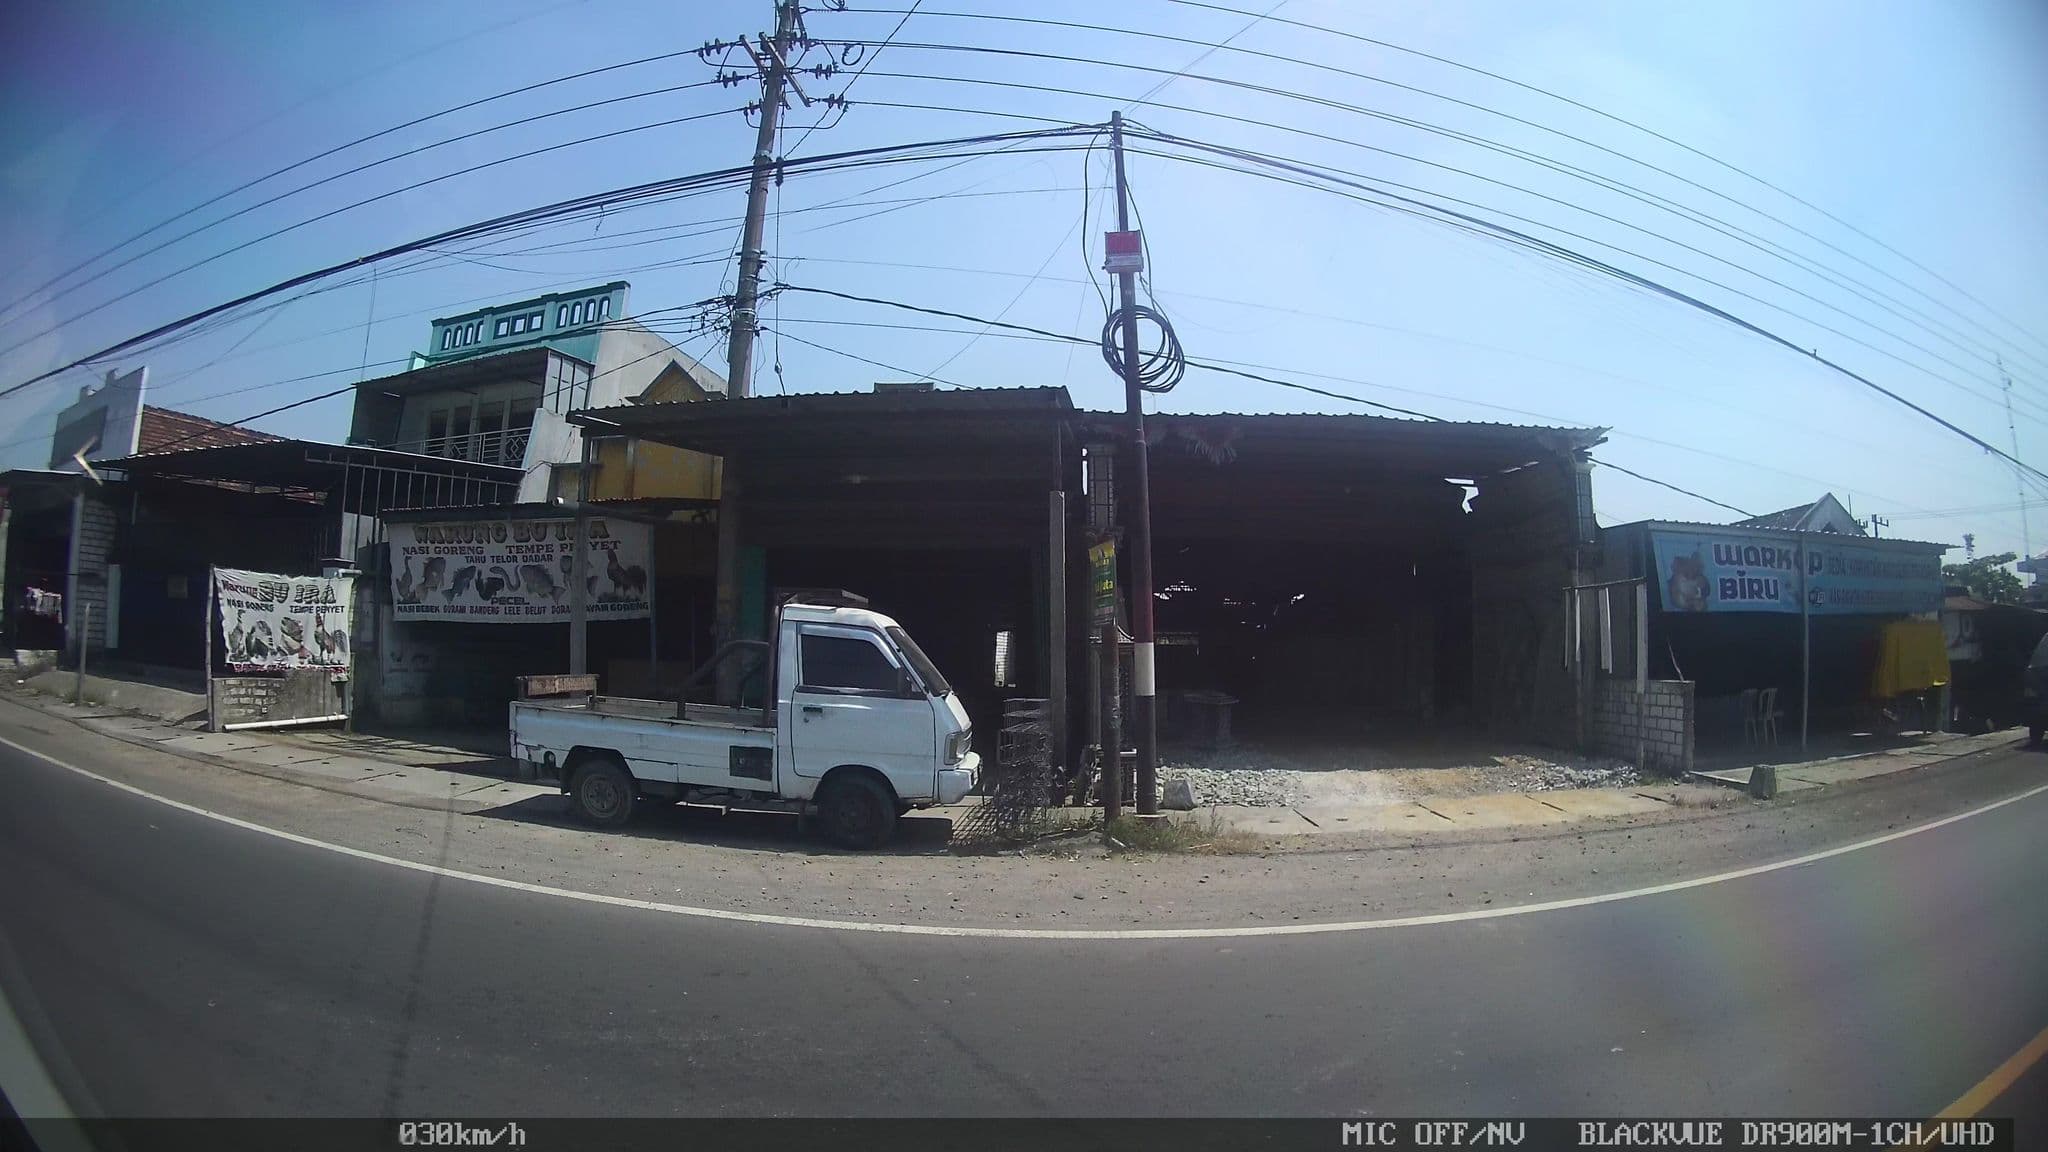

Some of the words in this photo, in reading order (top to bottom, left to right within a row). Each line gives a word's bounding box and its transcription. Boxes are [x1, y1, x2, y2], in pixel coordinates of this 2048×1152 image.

[413, 521, 508, 544] WARUNG
[512, 520, 547, 543] BU
[402, 546, 430, 556] NASI
[433, 545, 485, 555] GORENG
[505, 543, 554, 555] TEMPE
[560, 540, 622, 552] PYET
[464, 555, 487, 564] TAHU
[491, 555, 518, 563] TELOR
[522, 554, 553, 563] DADAR
[1719, 570, 1779, 601] BIRU
[294, 584, 337, 604] IRA
[226, 598, 245, 609] NASI
[490, 596, 530, 605] PECEL
[289, 605, 314, 613] TEMPE
[315, 605, 345, 613] PENYET
[396, 604, 415, 614] NASI
[504, 606, 521, 615] LELE
[525, 605, 547, 615] BELUT
